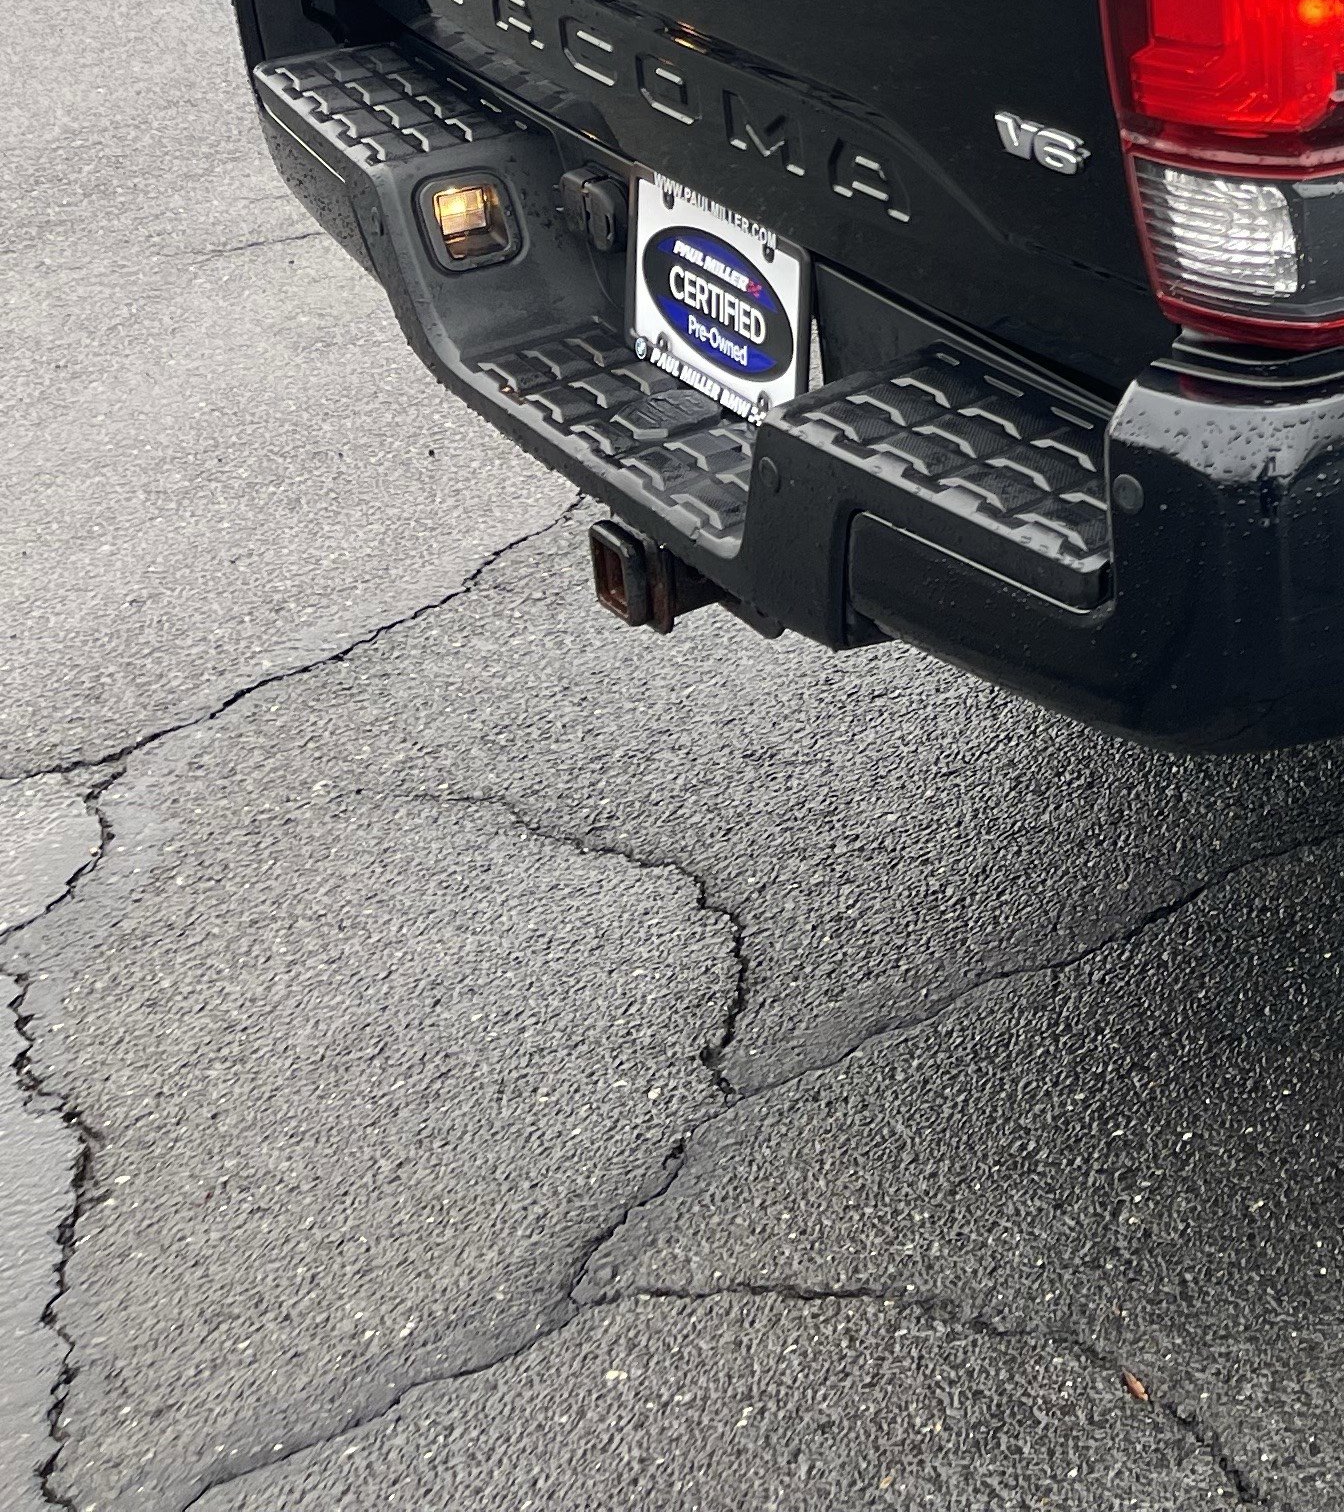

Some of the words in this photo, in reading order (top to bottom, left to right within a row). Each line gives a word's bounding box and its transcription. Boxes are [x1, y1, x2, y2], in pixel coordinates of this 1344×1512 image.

[994, 110, 1092, 176] V6
[653, 170, 777, 250] WWW.PAULMILLER.COM
[672, 239, 705, 267] PAUL
[703, 255, 750, 292] MILLER
[669, 265, 766, 345] CERTIFIED
[687, 314, 748, 366] Pre-Owned
[649, 347, 680, 377] PAUL
[679, 365, 722, 401] MILLER
[719, 388, 753, 418] BMW
